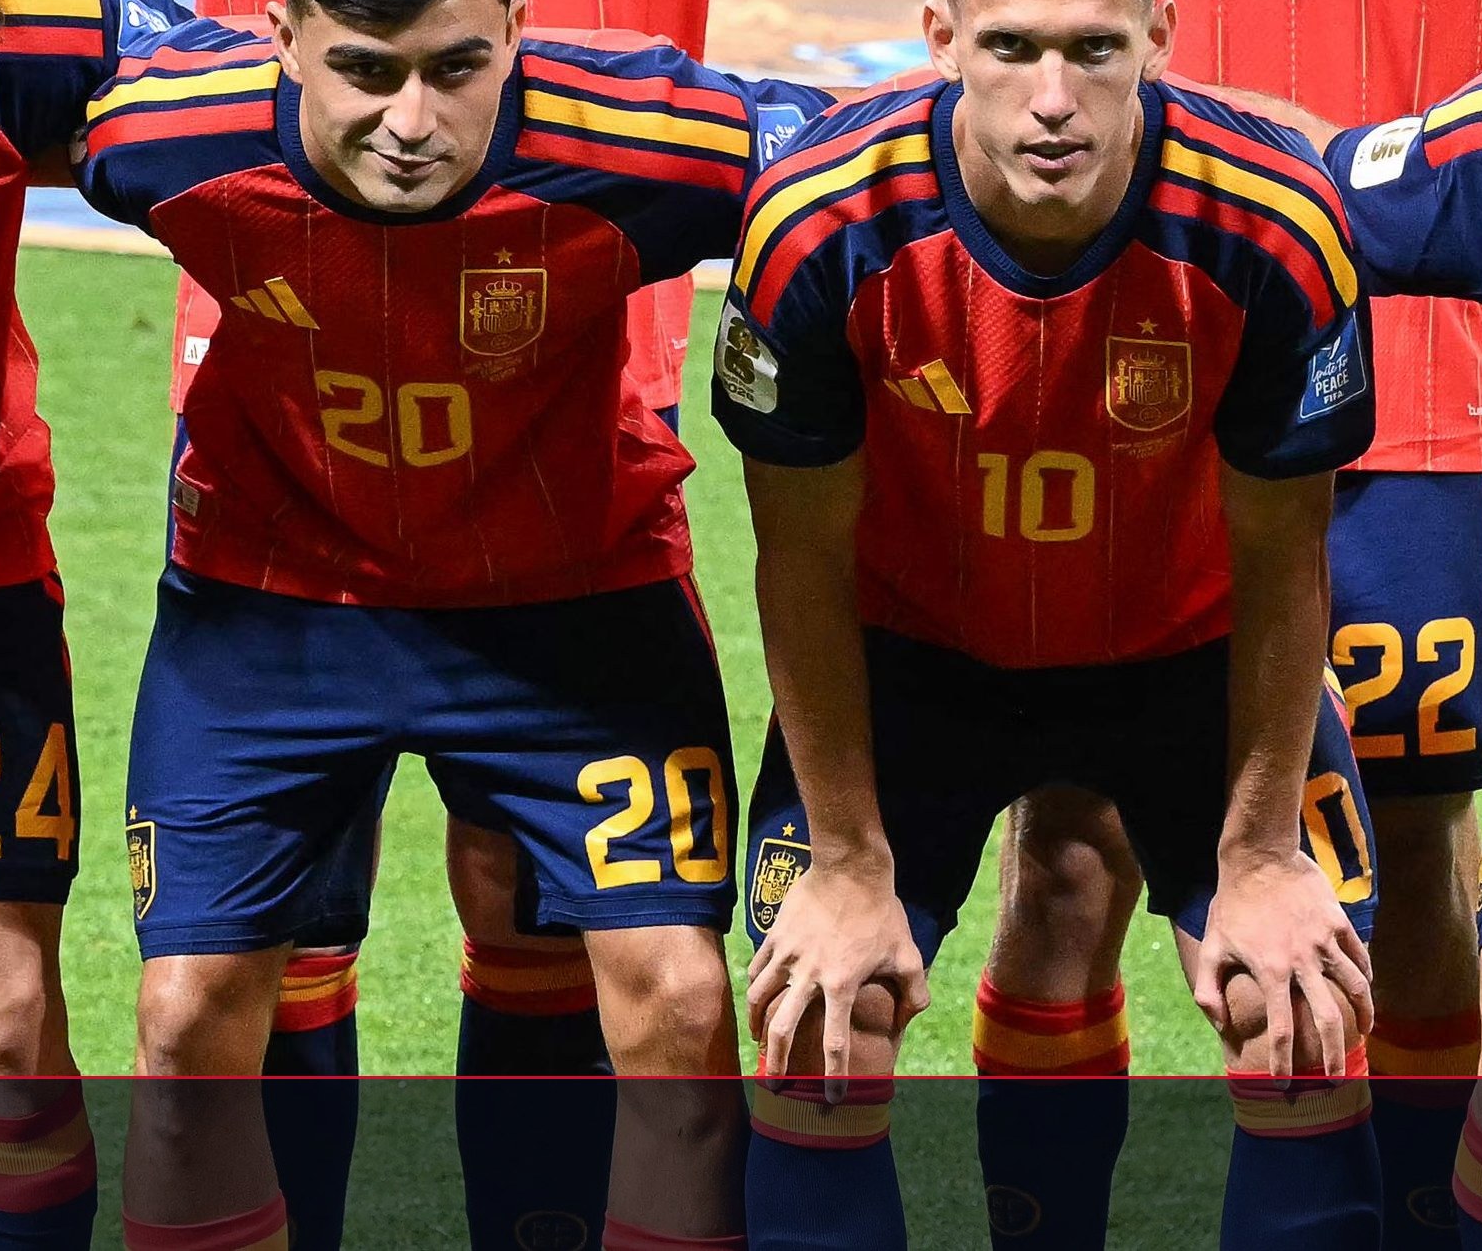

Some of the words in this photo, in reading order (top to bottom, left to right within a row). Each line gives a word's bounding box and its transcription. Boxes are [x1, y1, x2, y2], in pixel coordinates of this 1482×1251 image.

[314, 370, 474, 467] 20
[1316, 369, 1350, 398] PEACE
[1323, 390, 1345, 405] FIFA
[978, 451, 1096, 543] 10
[1333, 617, 1476, 757] 22
[578, 747, 728, 890] 20
[1304, 773, 1373, 903] 0
